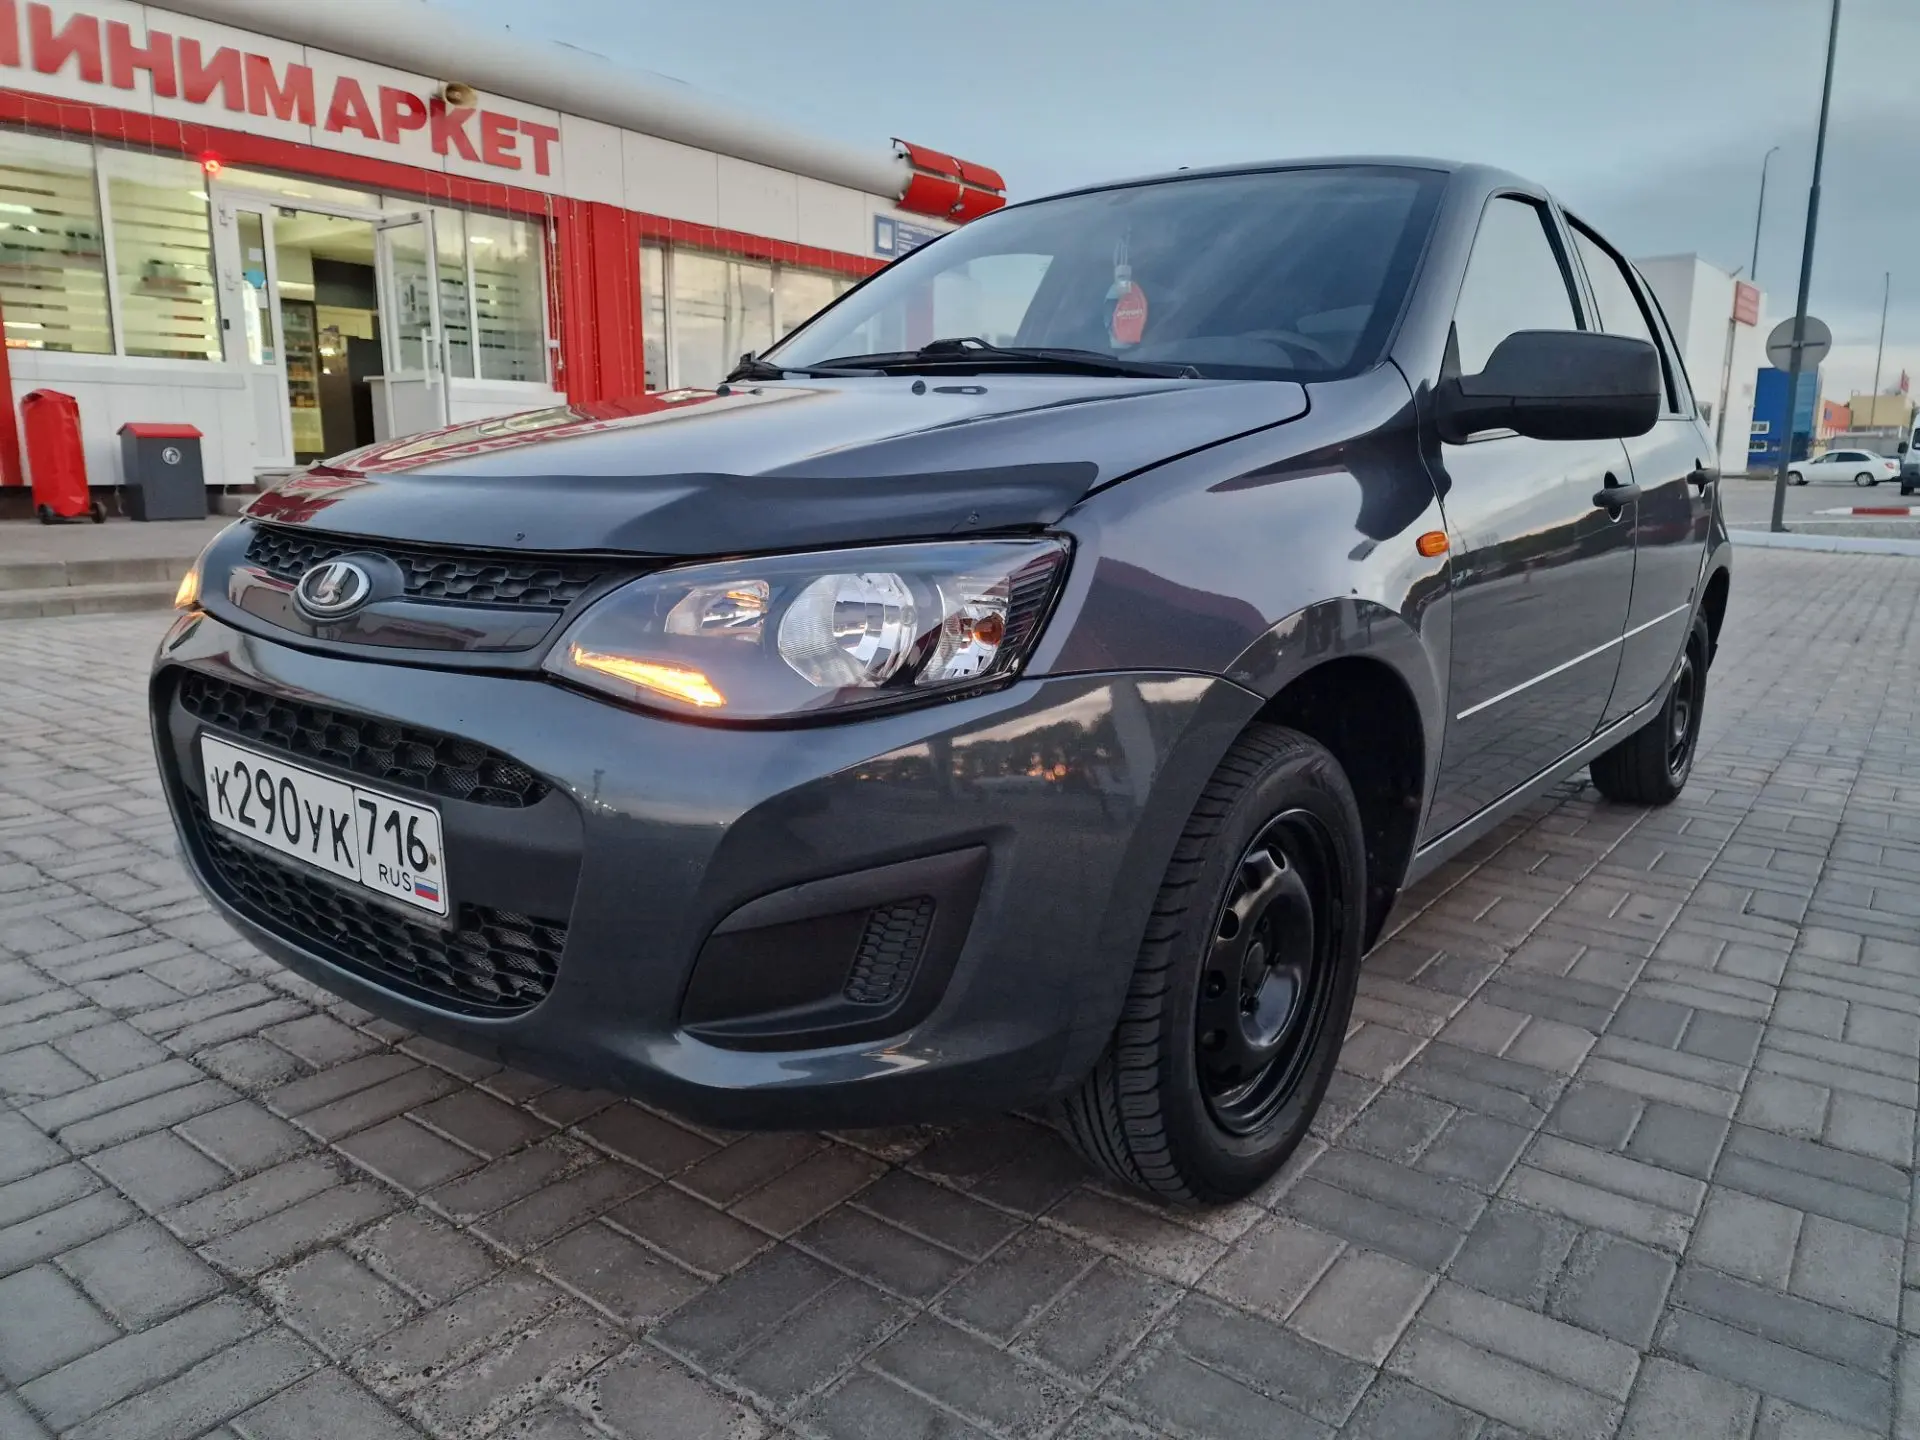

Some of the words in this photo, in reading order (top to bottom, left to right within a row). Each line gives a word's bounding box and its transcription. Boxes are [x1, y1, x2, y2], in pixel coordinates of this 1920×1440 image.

[0, 0, 559, 176] ИНИМАРКЕТ
[358, 798, 429, 872] 716
[378, 863, 412, 892] RUS
